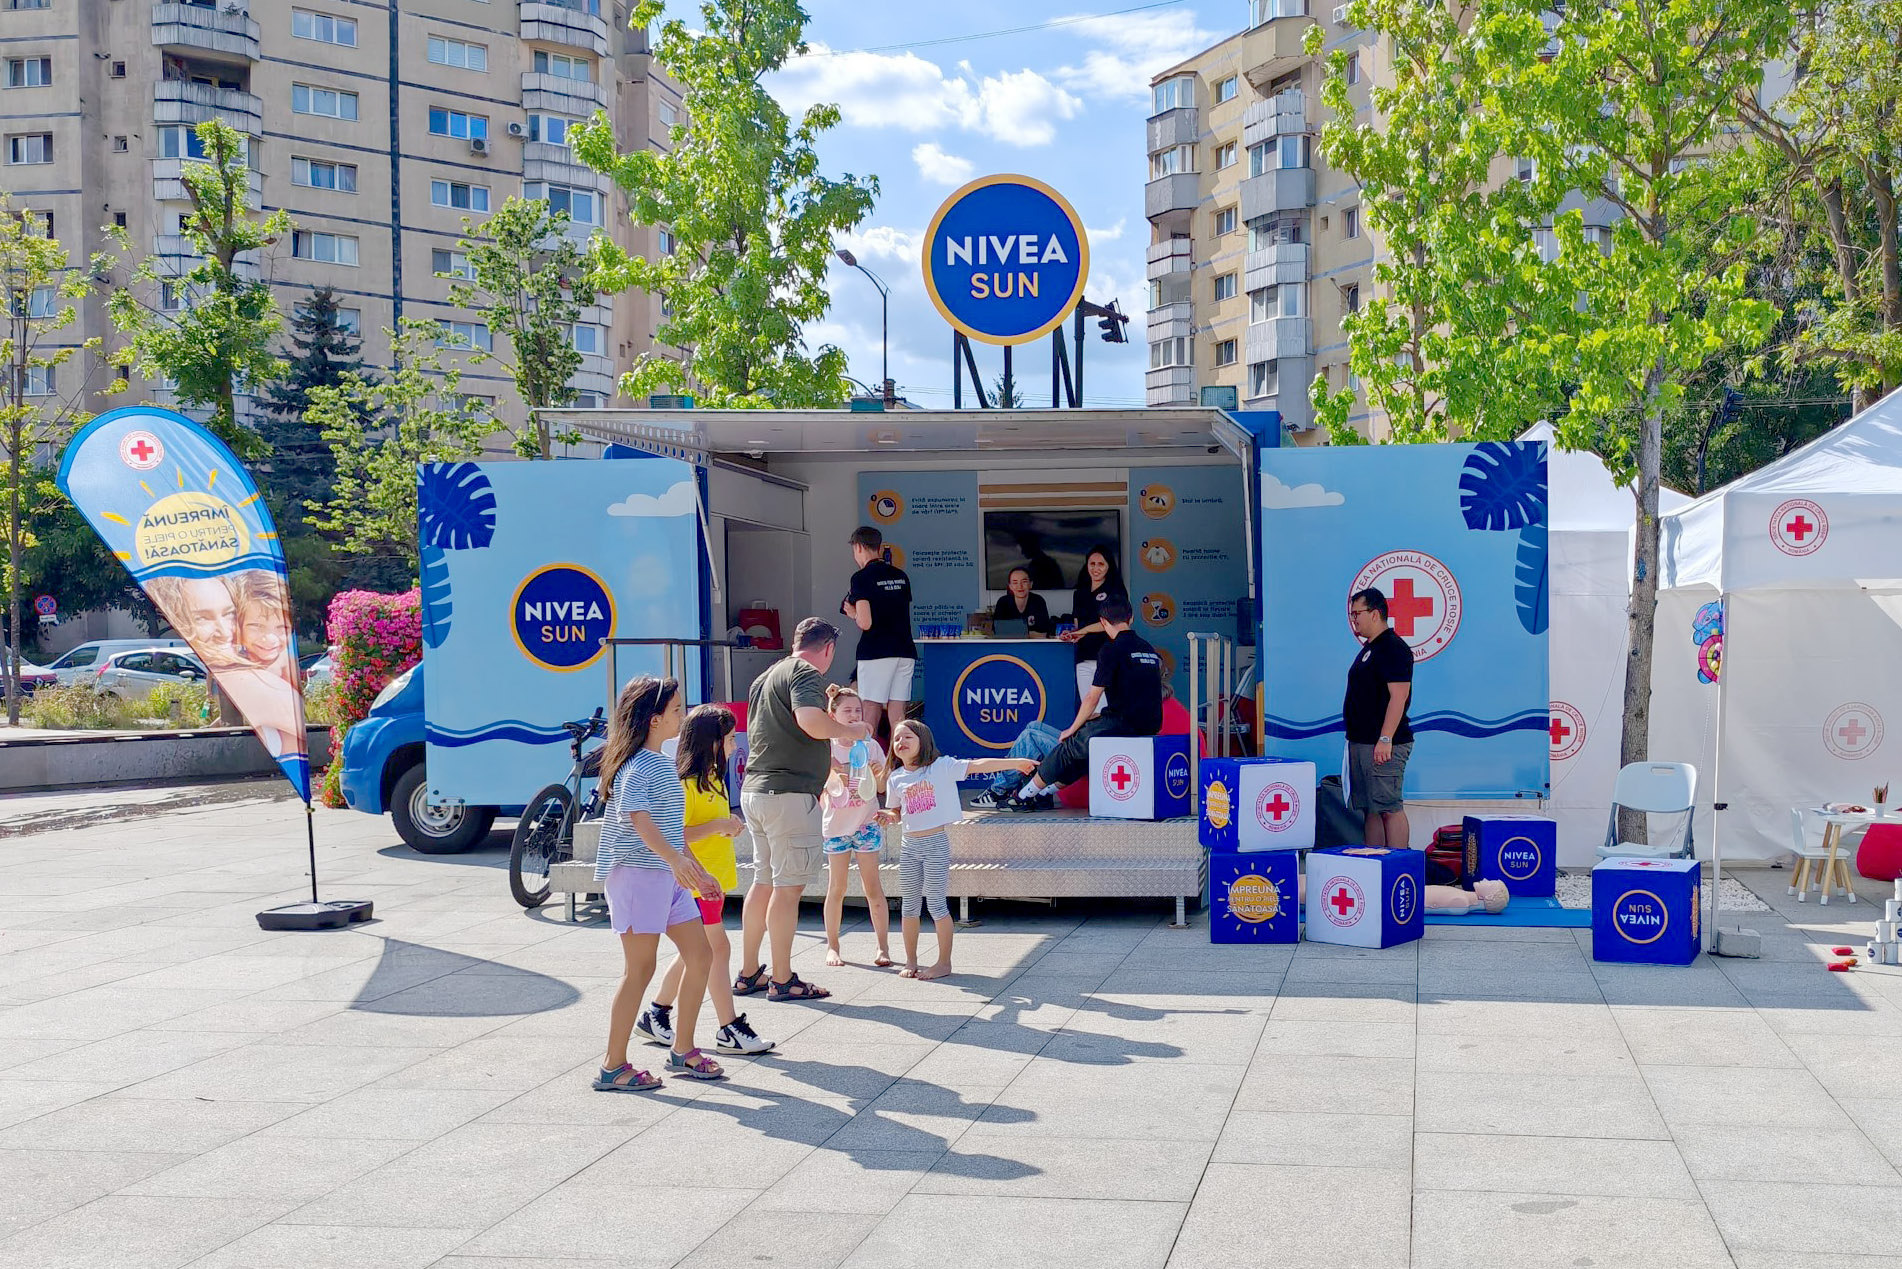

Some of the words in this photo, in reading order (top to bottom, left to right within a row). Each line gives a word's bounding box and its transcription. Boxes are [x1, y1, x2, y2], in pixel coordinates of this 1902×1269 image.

[946, 233, 1068, 266] NIVEA
[970, 272, 1038, 299] SUN
[1424, 560, 1438, 572] DE
[1436, 570, 1456, 602] CRUCE
[525, 600, 604, 621] NIVEA
[541, 625, 585, 643] SUN
[967, 688, 1034, 705] NIVEA
[980, 708, 1018, 723] SUN
[1168, 768, 1188, 778] NIVEA
[1504, 852, 1535, 860] NIVEA
[1629, 904, 1652, 913] SUN
[1620, 914, 1660, 925] NIVEA
